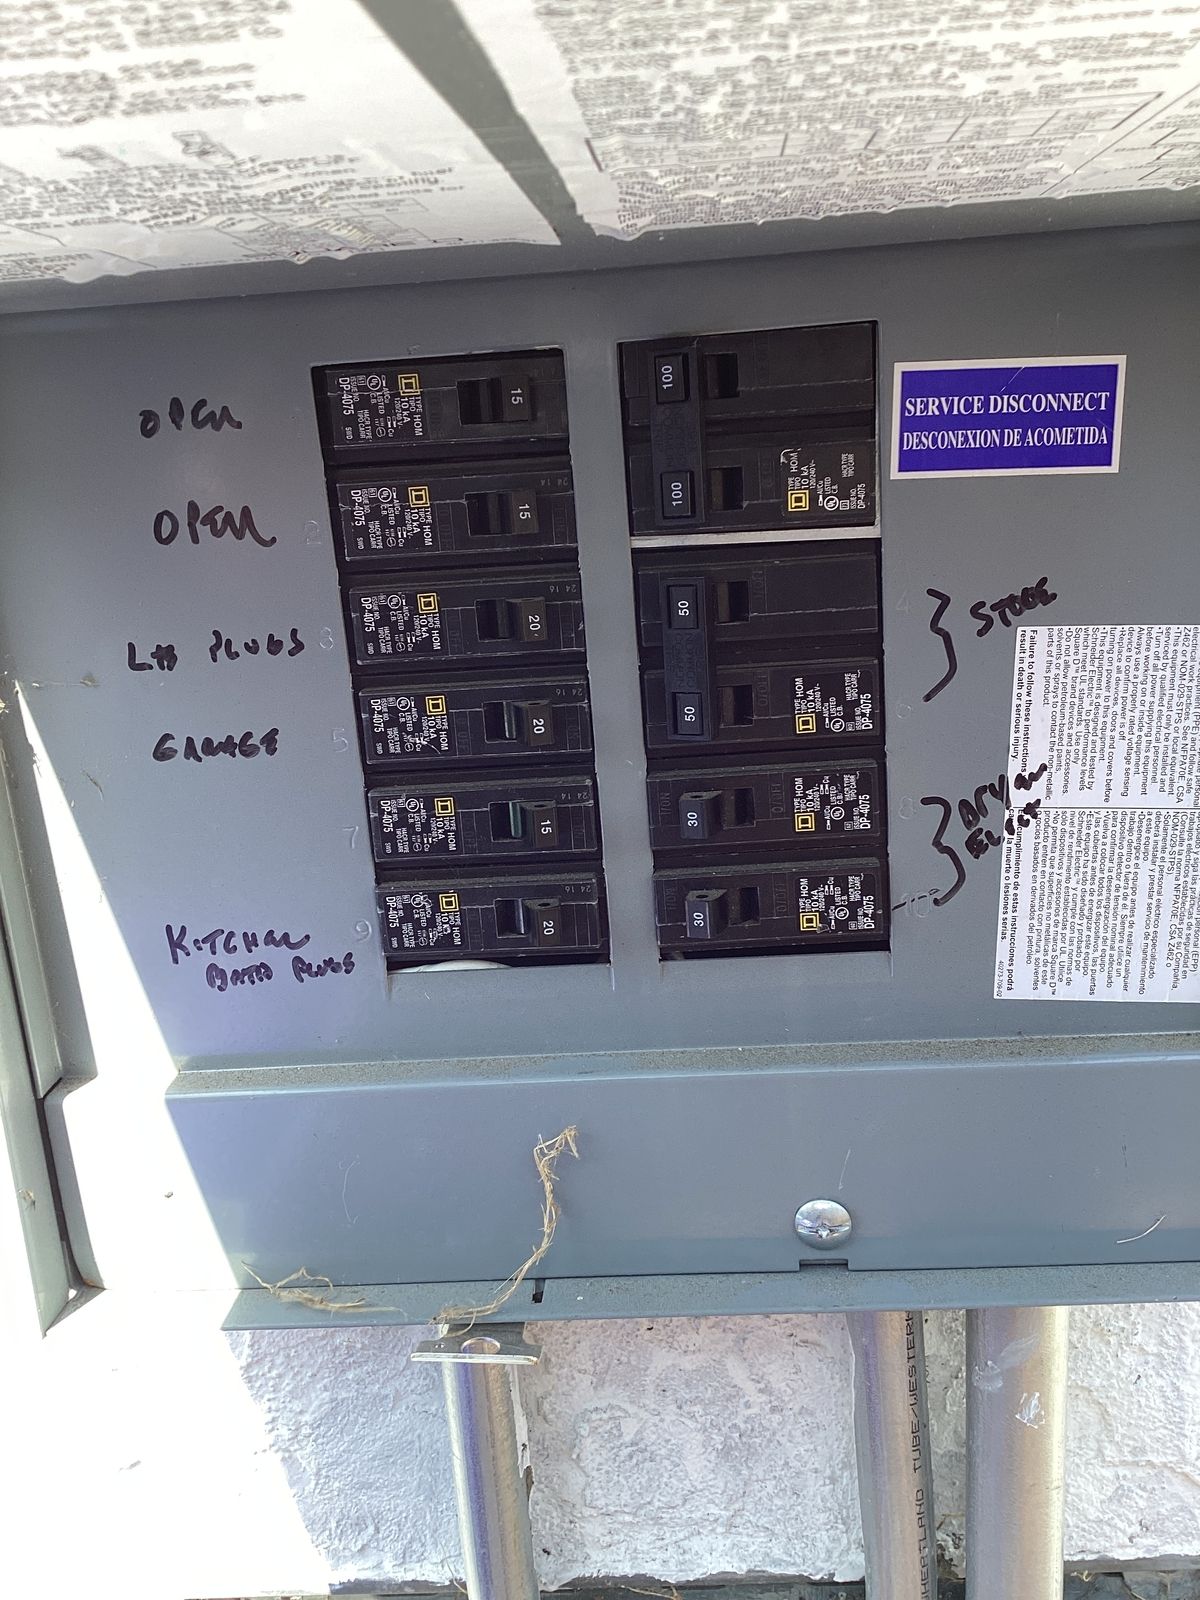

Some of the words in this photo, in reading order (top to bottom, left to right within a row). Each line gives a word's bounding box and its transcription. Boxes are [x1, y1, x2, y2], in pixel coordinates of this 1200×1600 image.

[661, 365, 674, 390] 100
[339, 377, 354, 415] DP-4075
[400, 397, 409, 408] 10
[511, 387, 523, 405] 15
[905, 395, 984, 417] SERVICE
[988, 392, 1110, 414] DISCONNECT
[402, 411, 410, 423] kA
[413, 414, 423, 436] HOM
[902, 429, 1000, 451] DESCONEXION
[1003, 428, 1022, 448] DE
[1024, 426, 1108, 447] ACOMETIDA
[790, 452, 798, 472] HOM
[800, 465, 808, 476] kA
[671, 482, 683, 506] 100
[801, 478, 809, 490] 10
[857, 483, 866, 509] DP-4075
[350, 490, 365, 526] DP-4075
[410, 508, 419, 520] 10
[519, 503, 530, 520] 15
[412, 522, 421, 534] kA
[423, 525, 432, 546] HOM
[360, 597, 375, 632] DP-4075
[678, 600, 689, 616] 50
[420, 614, 428, 625] 10
[528, 615, 541, 630] 20
[421, 627, 430, 638] kA
[431, 630, 441, 650] HOM
[1019, 629, 1027, 654] result
[1046, 627, 1055, 647] parts
[1071, 627, 1081, 656] Square
[1106, 626, 1116, 654] turning
[1144, 626, 1153, 652] before
[1182, 626, 1191, 647] Z462
[1028, 629, 1037, 659] Failure
[1046, 649, 1053, 658] of
[1180, 649, 1187, 658] or
[1018, 656, 1025, 664] in
[1027, 660, 1034, 669] to
[1106, 656, 1112, 666] on
[1140, 653, 1150, 685] working
[794, 677, 804, 698] HOM
[1016, 666, 1024, 690] death
[1025, 671, 1033, 697] follow
[1069, 675, 1077, 698] brand
[1102, 668, 1111, 693] power
[806, 689, 814, 700] kA
[1016, 691, 1020, 701] or
[1140, 686, 1146, 697] on
[1174, 659, 1187, 724] NOM-029-STPS
[807, 702, 816, 713] 10
[860, 694, 872, 730] DP-4075
[1023, 699, 1031, 722] these
[1139, 698, 1145, 707] or
[370, 699, 384, 733] DP-4075
[428, 716, 436, 726] 10
[684, 706, 696, 722] 50
[1013, 703, 1021, 734] serious
[1067, 700, 1075, 730] devices
[1137, 709, 1145, 732] inside
[430, 728, 438, 739] kA
[532, 718, 545, 734] 20
[1173, 725, 1179, 734] or
[440, 731, 448, 751] HOM
[1019, 724, 1029, 772] instructions
[1065, 732, 1073, 746] and
[1171, 735, 1179, 754] local
[794, 777, 804, 797] HOM
[806, 788, 814, 800] kA
[380, 800, 394, 833] DP-4075
[806, 801, 814, 812] 10
[858, 794, 870, 830] DP-4075
[436, 817, 444, 828] 10
[540, 820, 552, 834] 15
[688, 812, 698, 828] 30
[1041, 810, 1051, 842] producto
[438, 830, 446, 840] kA
[448, 832, 456, 851] HOM
[1108, 829, 1117, 864] confirmar
[1005, 846, 1013, 875] muerte
[1107, 865, 1114, 873] la
[1040, 869, 1045, 879] en
[800, 878, 808, 897] HOM
[810, 889, 818, 900] kA
[1013, 880, 1020, 890] de
[811, 900, 819, 912] 10
[1002, 882, 1010, 915] lesiones
[1011, 892, 1019, 913] estas
[1037, 880, 1045, 912] contacto
[1100, 874, 1113, 934] desenergización
[386, 896, 400, 928] DP-4075
[441, 912, 449, 923] 10
[694, 912, 704, 927] 30
[863, 895, 875, 929] DP-4075
[452, 926, 462, 945] HOM
[543, 920, 554, 935] 20
[1007, 915, 1017, 967] instrucciones
[1004, 968, 1013, 990] podrá
[1031, 956, 1039, 990] solventes
[915, 1489, 930, 1600] HEATLAND
